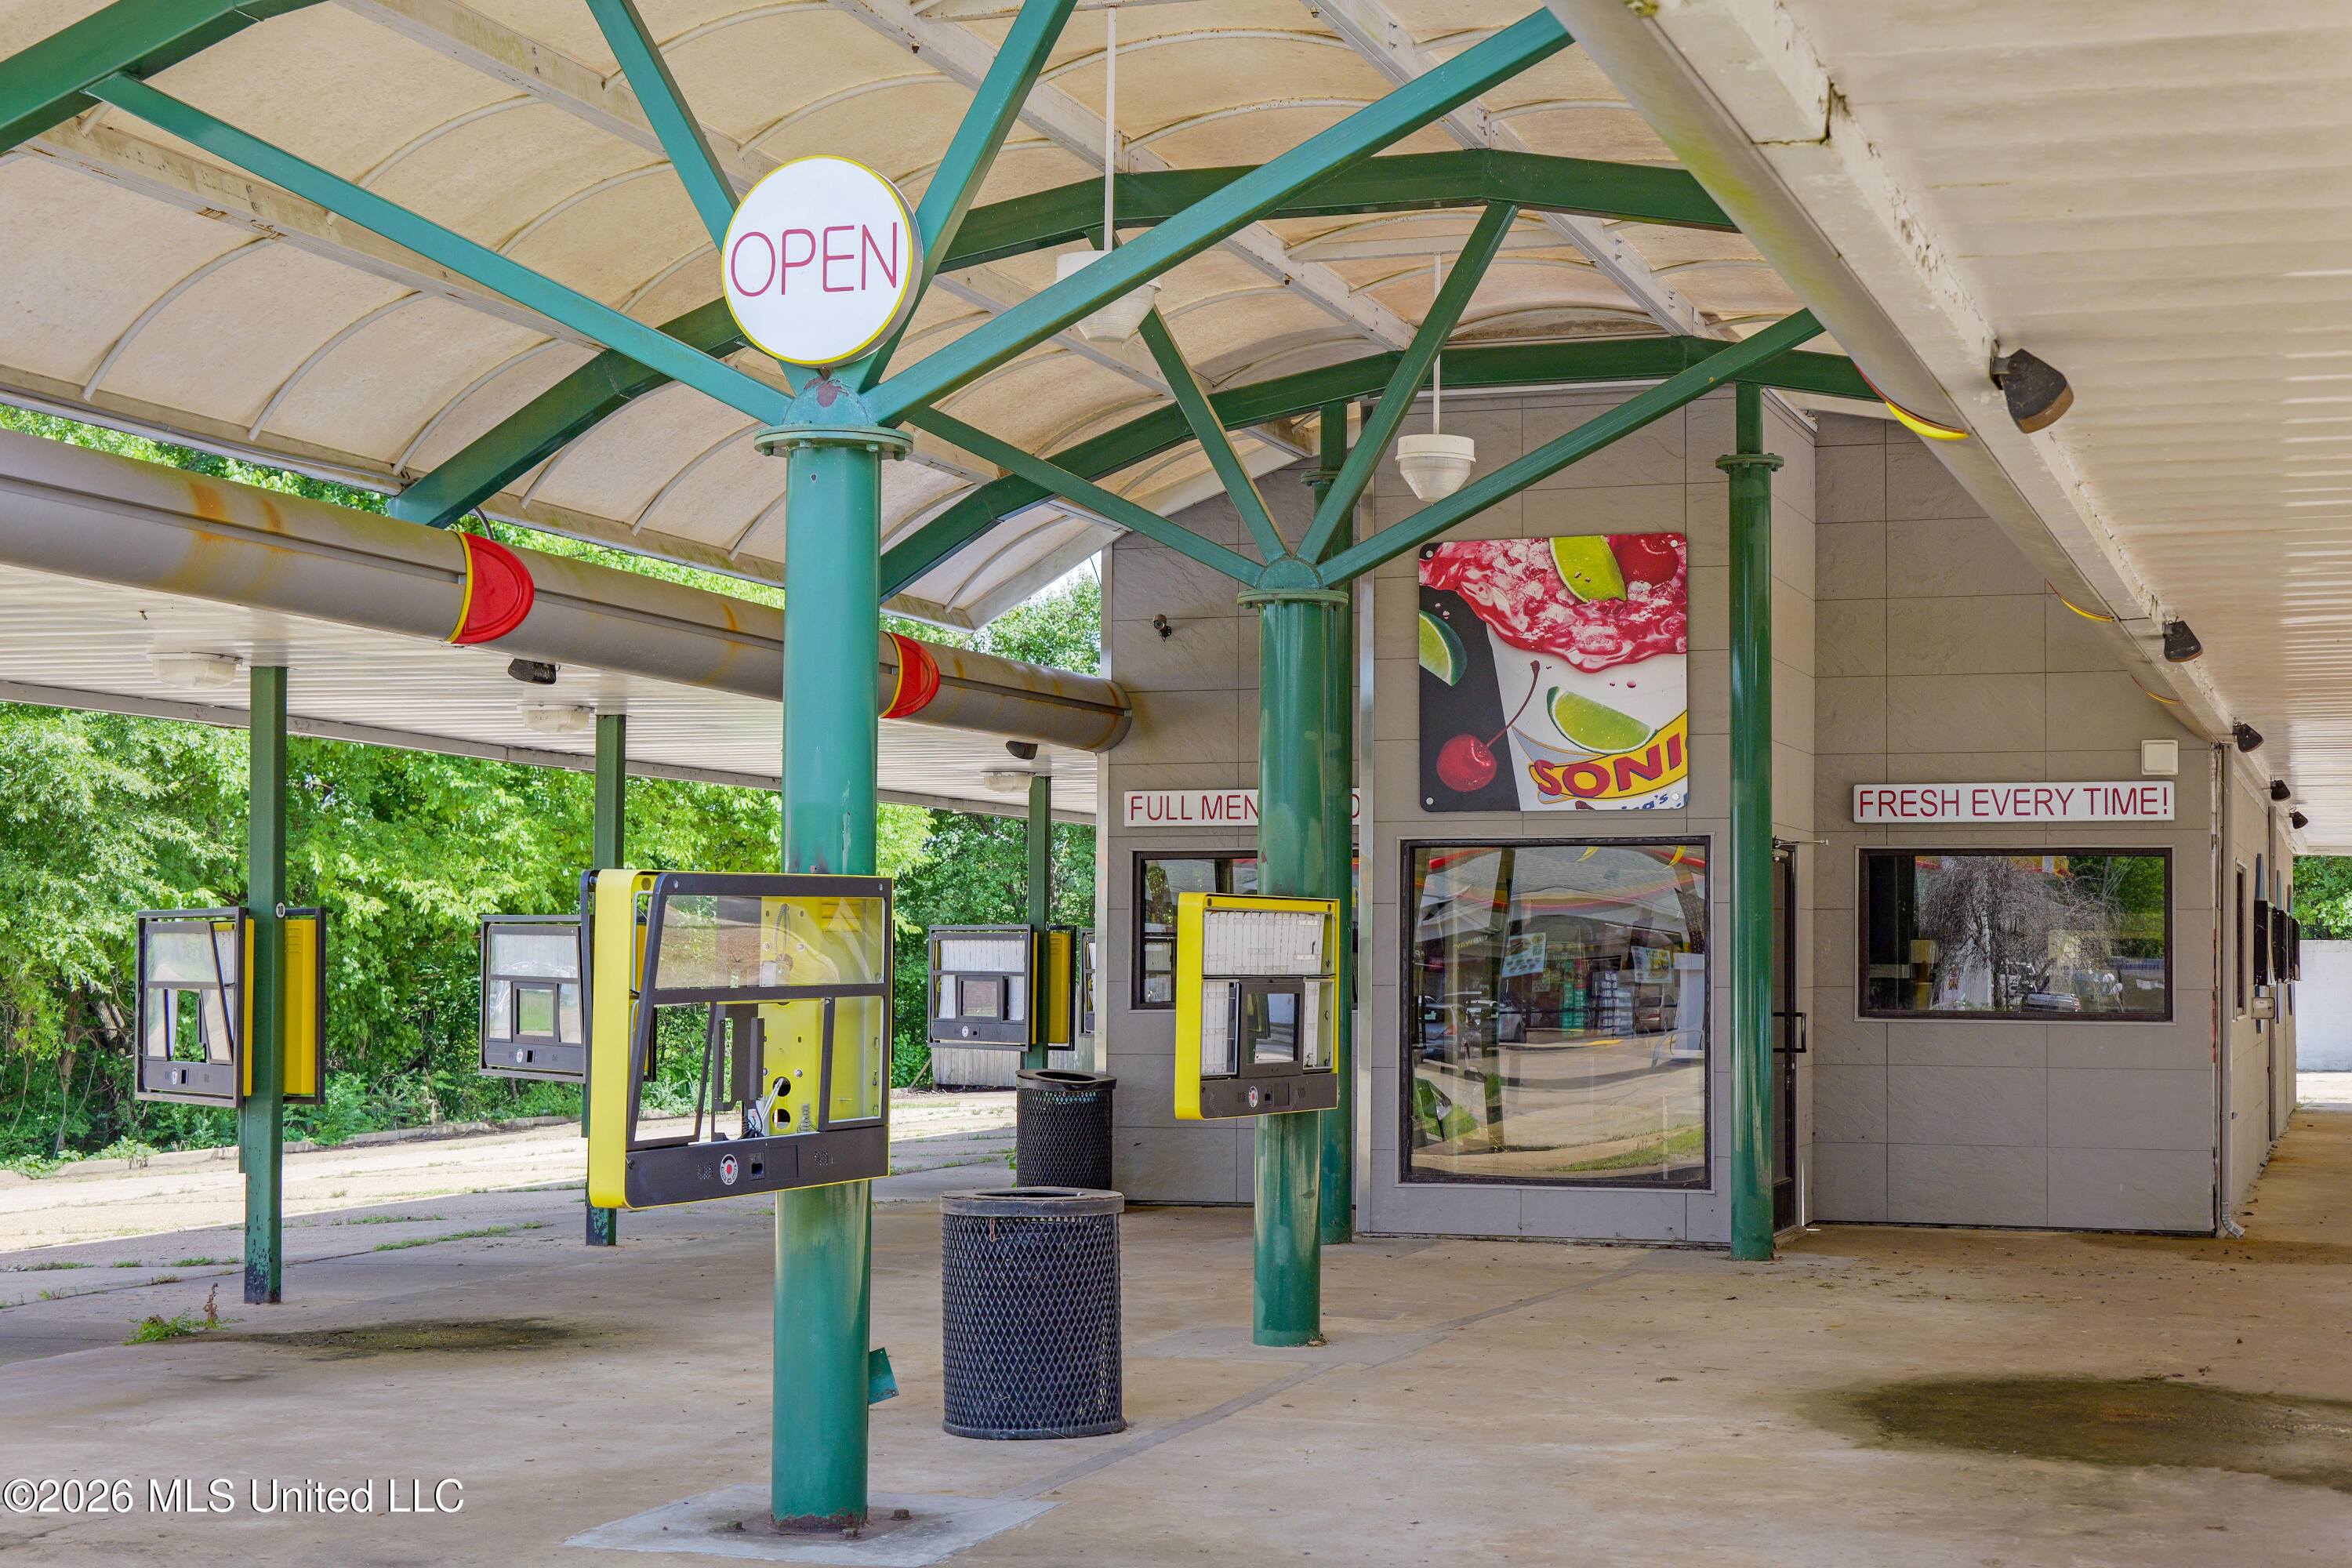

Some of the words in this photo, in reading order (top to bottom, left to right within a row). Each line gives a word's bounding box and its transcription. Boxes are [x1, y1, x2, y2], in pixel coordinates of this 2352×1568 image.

[731, 222, 898, 297] OPEN
[1534, 732, 1687, 798] SONI
[1131, 796, 1192, 821] FULL
[1202, 794, 1259, 820] MEN
[1860, 789, 1959, 818] FRESH
[1973, 787, 2075, 816] EVERY
[2083, 787, 2169, 815] TIME!
[278, 906, 284, 915] 10
